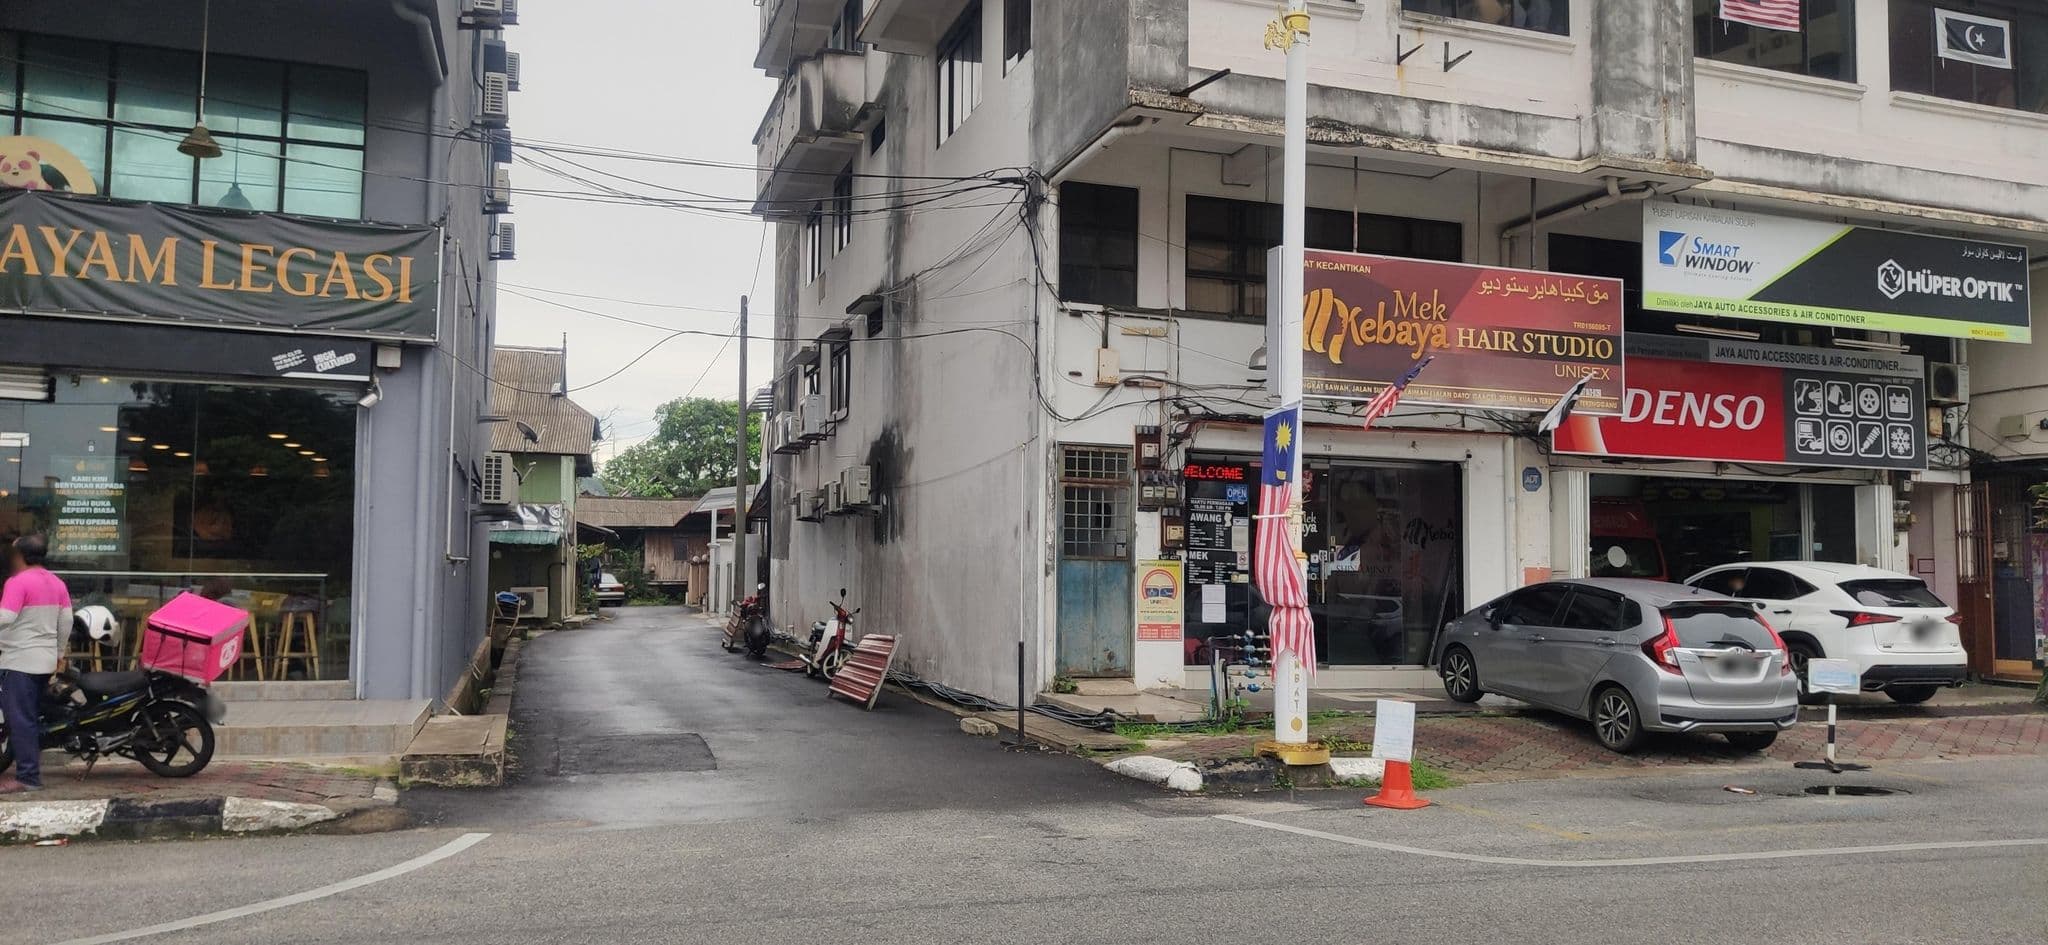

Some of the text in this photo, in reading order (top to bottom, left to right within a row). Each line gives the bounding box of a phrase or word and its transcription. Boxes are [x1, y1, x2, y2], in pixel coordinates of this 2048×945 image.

[1692, 236, 1740, 258] SMART
[0, 223, 414, 304] AYAM LEGASI
[1316, 261, 1371, 274] KECANTIKAN
[1685, 255, 1754, 274] WINDOW
[1907, 268, 1962, 298] HÜPER
[1962, 277, 2014, 302] OPTIK
[1393, 288, 1448, 321] Mek
[1694, 300, 1713, 310] JAYA
[1715, 302, 1736, 312] AUTO
[1738, 304, 1792, 318] ACCESSORIES
[1800, 310, 1813, 320] AIR
[1815, 311, 1866, 324] CONDITIONER
[1350, 301, 1450, 360] Kebaya
[1457, 327, 1614, 359] HAIR STUDIO
[1715, 346, 1900, 371] JAYA AUTO ACCESSORIES & AIR-CONDITIONER
[1555, 364, 1611, 381] UNISEX
[1620, 388, 1765, 430] DENSO
[1226, 487, 1247, 498] OPEN
[1190, 513, 1222, 523] AWANG
[1189, 551, 1208, 560] MEK
